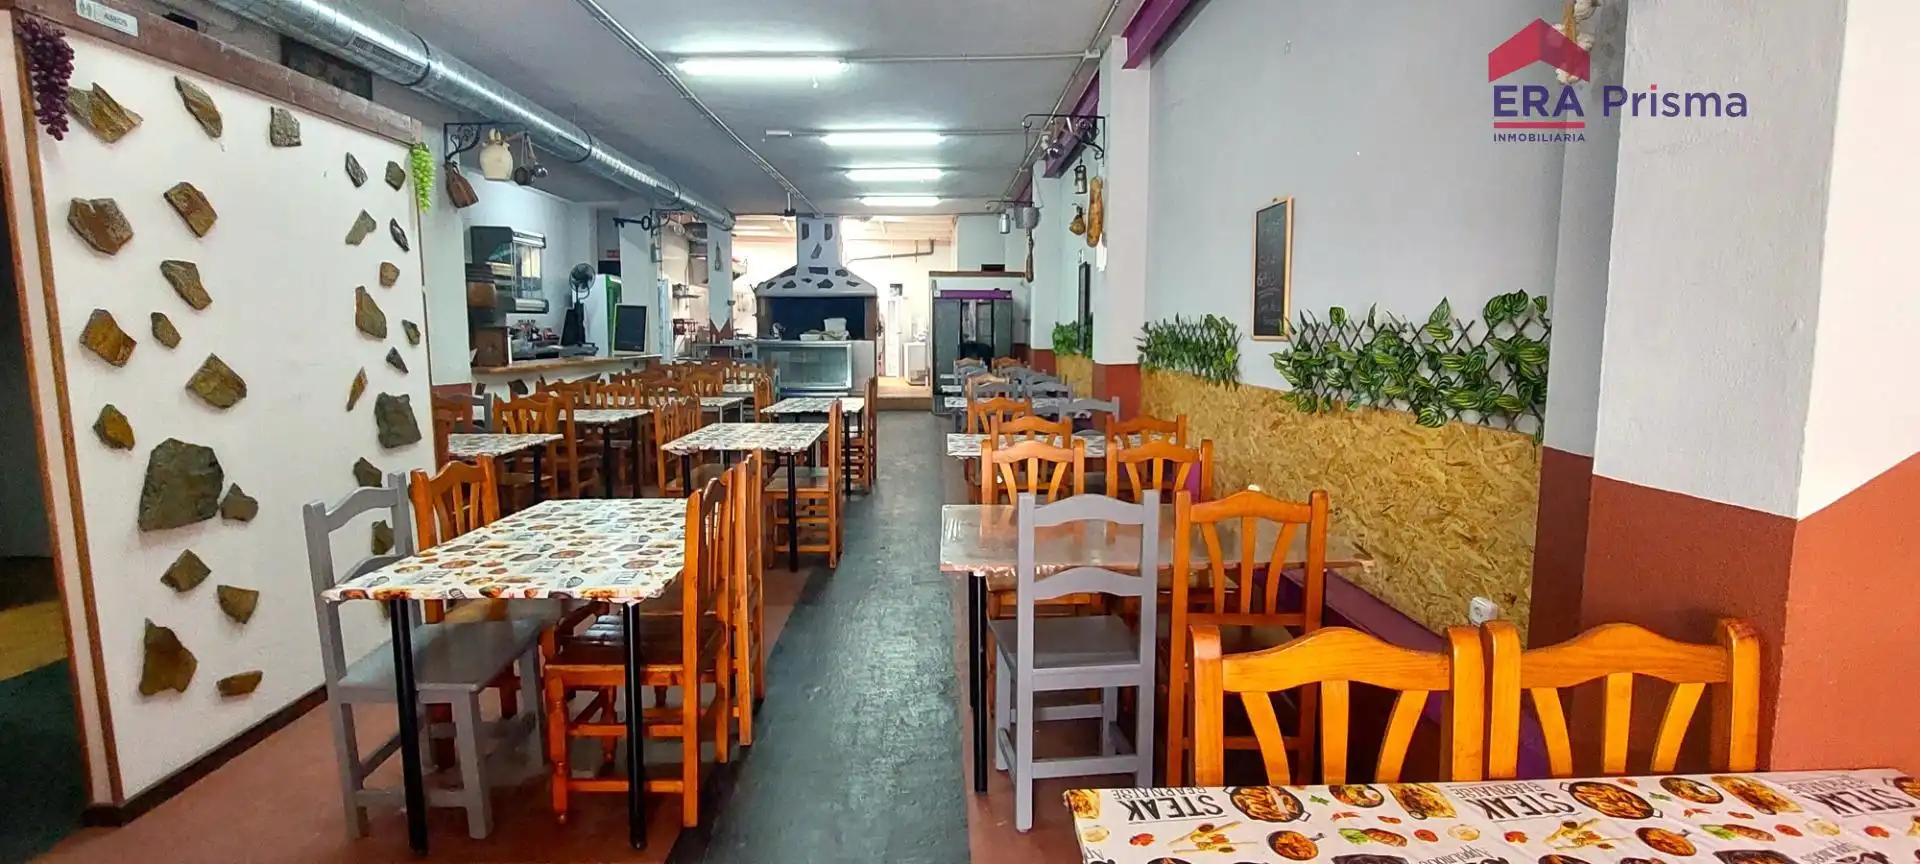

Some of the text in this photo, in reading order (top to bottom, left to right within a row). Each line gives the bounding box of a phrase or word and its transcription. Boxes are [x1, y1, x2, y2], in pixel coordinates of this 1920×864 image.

[1118, 794, 1224, 821] STEAK
[1464, 792, 1575, 820] STEAK
[1800, 788, 1916, 815] STEAK
